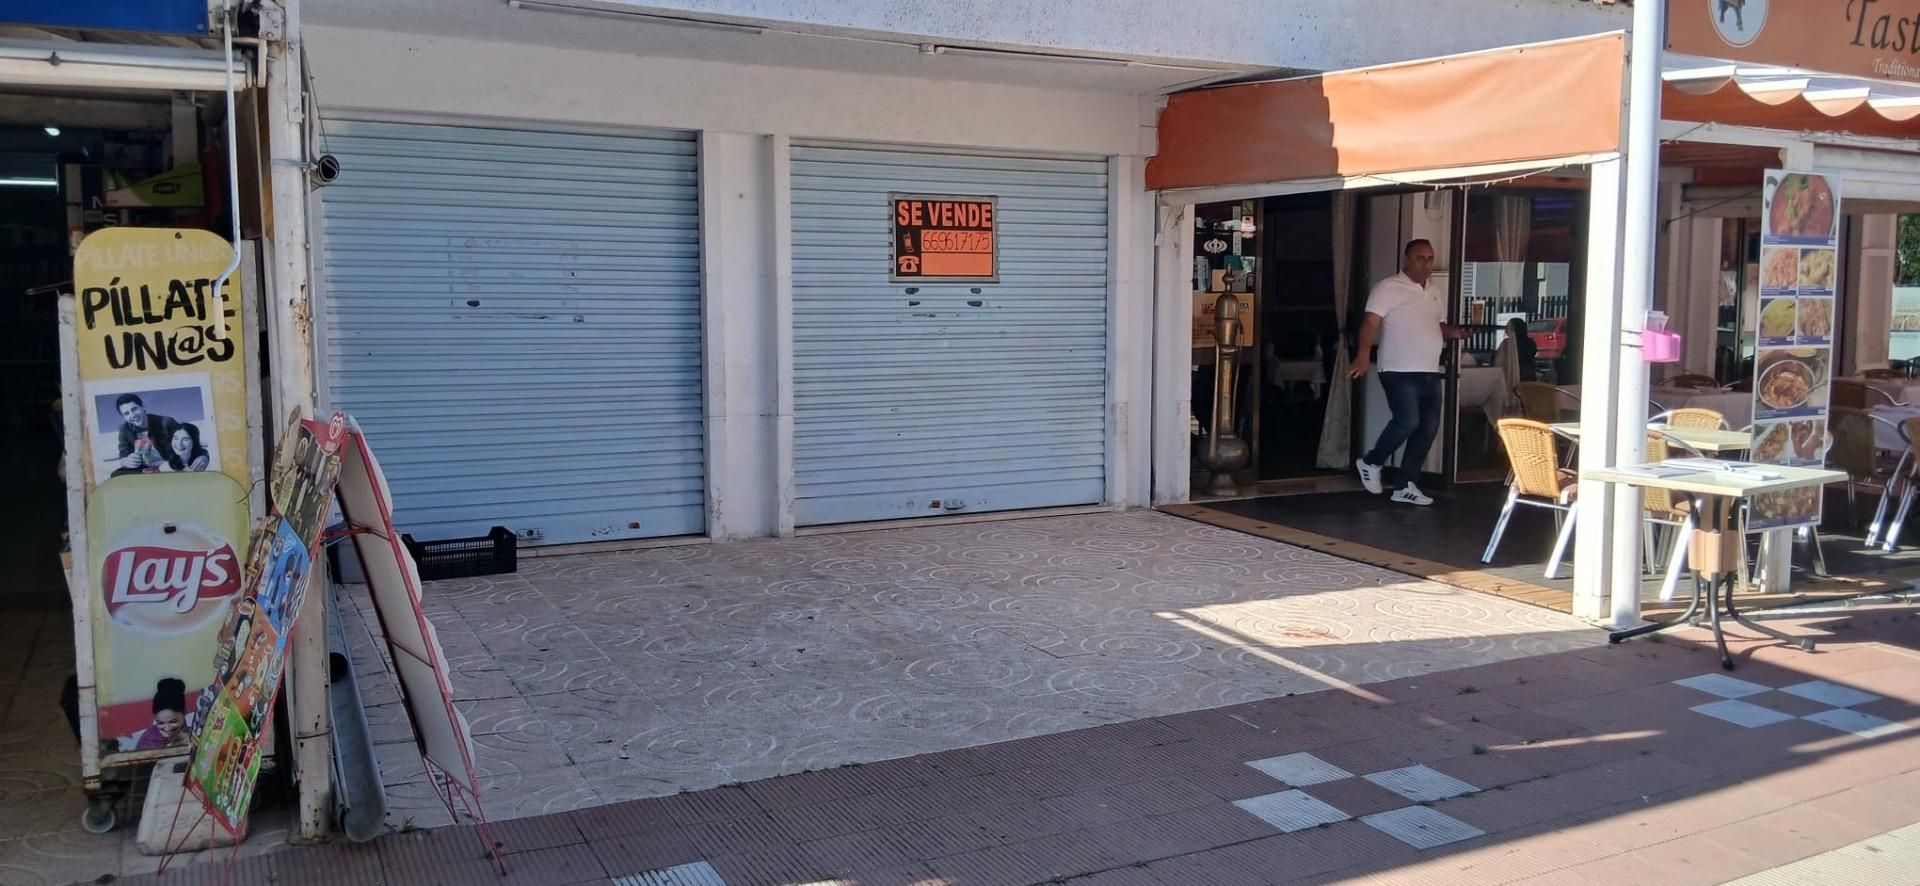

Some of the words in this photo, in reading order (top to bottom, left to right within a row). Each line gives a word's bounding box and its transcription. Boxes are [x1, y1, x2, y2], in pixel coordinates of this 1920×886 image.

[898, 201, 923, 226] SE
[927, 202, 992, 228] VENDE
[922, 231, 990, 251] 669617175
[104, 325, 235, 371] UN@S
[112, 548, 231, 614] Lay's
